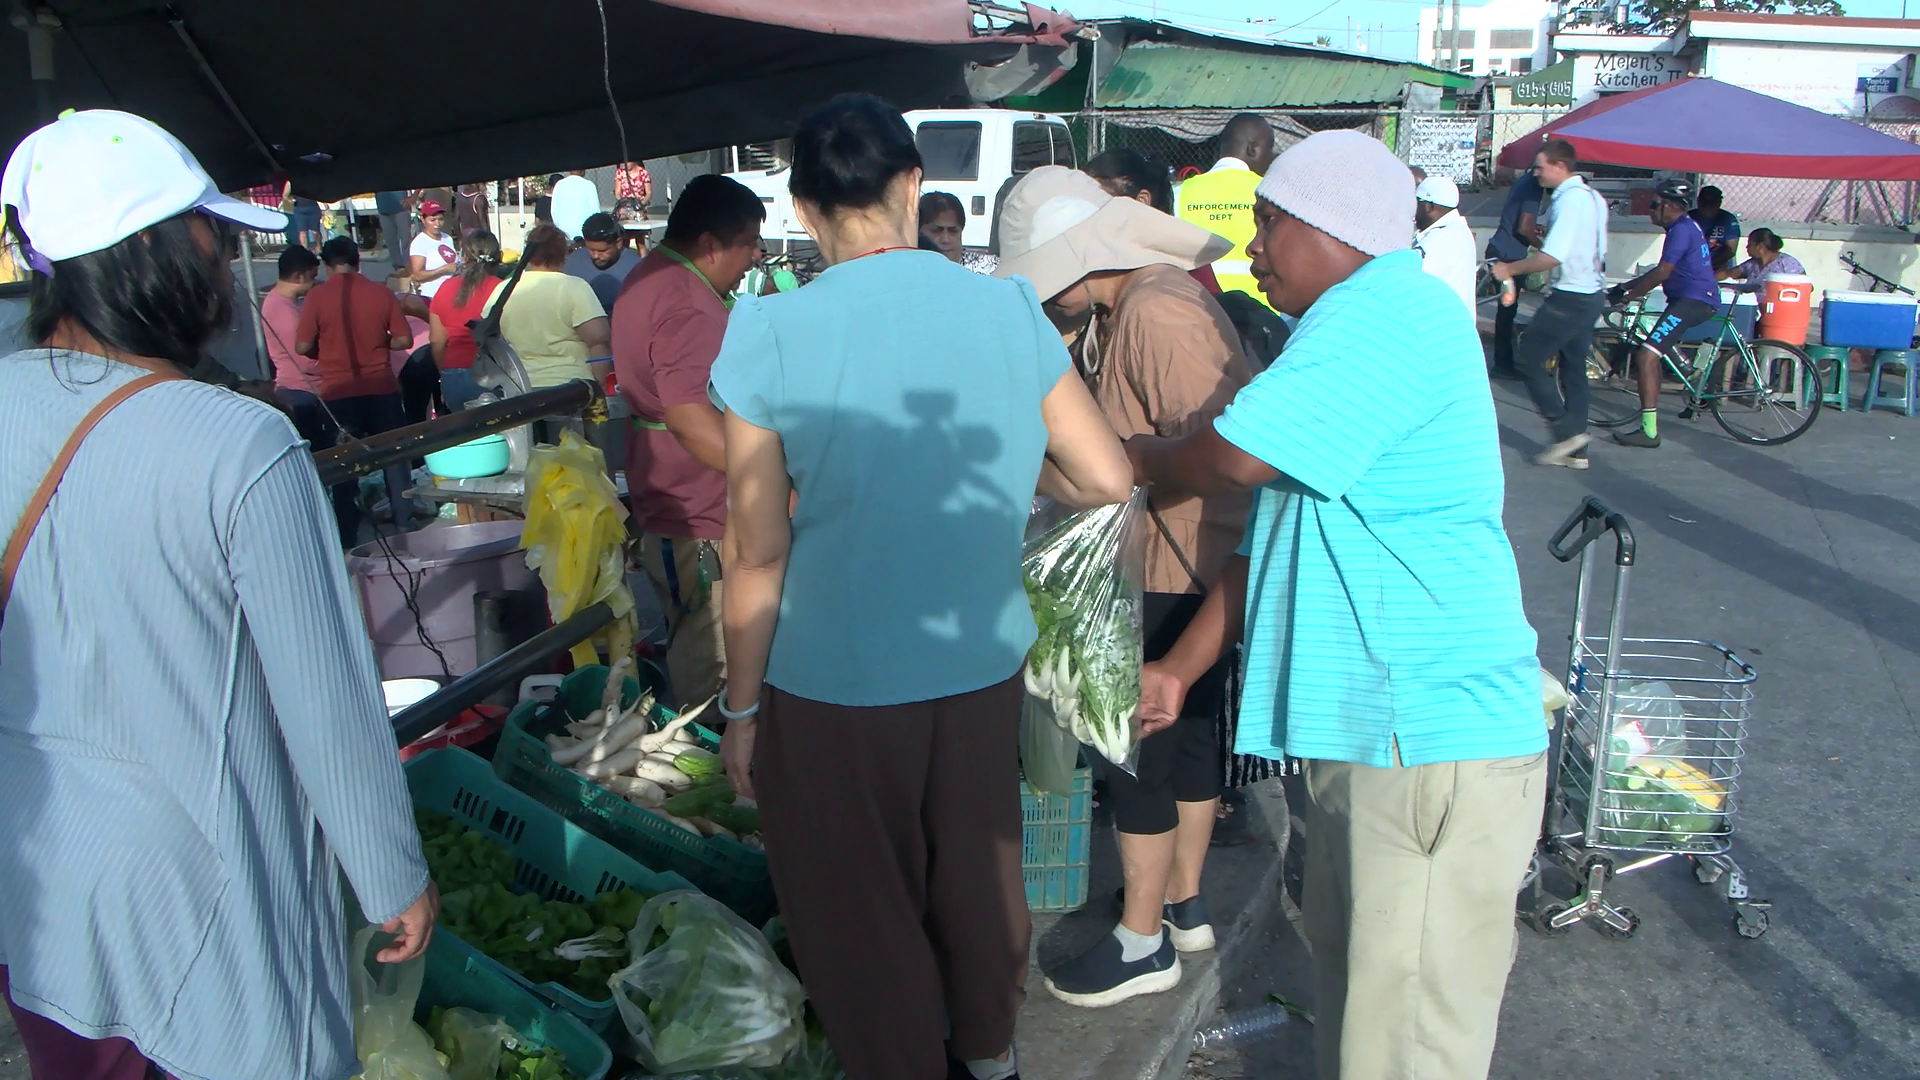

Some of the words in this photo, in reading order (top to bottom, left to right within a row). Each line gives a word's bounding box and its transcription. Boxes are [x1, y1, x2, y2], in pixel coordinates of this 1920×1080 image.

[1594, 53, 1665, 71] Melen's
[1594, 72, 1660, 88] Kitchen
[1651, 314, 1683, 343] PMA
